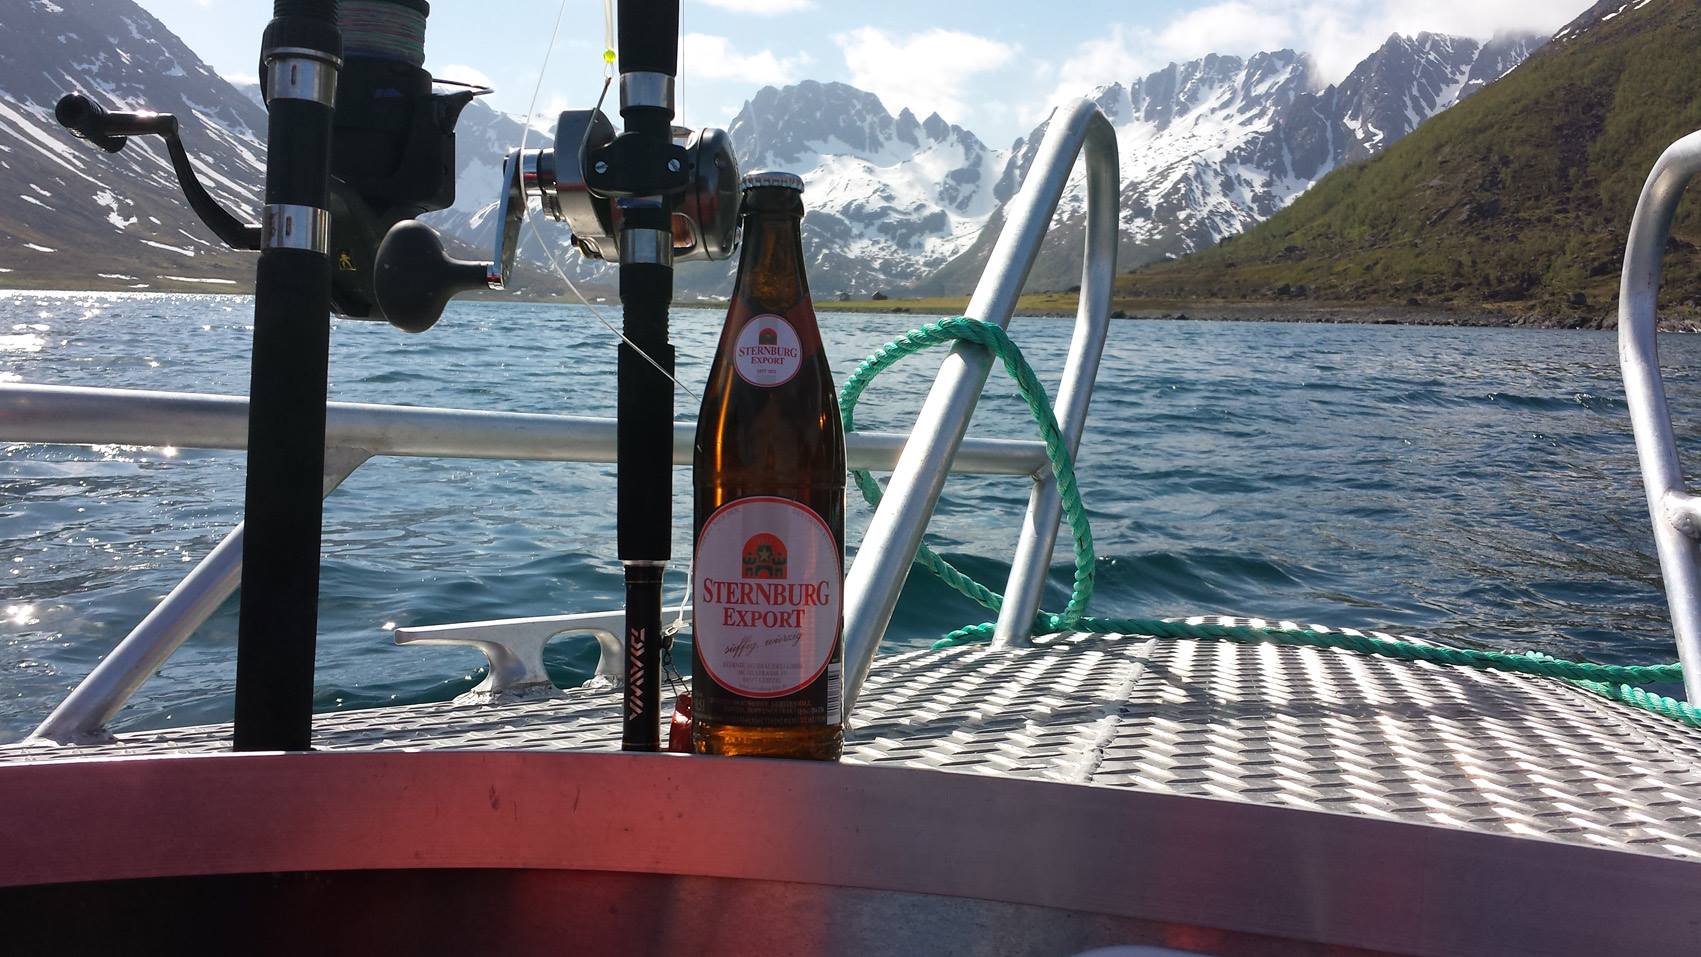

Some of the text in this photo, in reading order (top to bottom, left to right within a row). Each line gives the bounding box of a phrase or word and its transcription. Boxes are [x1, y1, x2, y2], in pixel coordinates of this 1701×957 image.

[738, 346, 798, 358] STERNBURG
[751, 356, 785, 365] EXPORT
[703, 578, 830, 606] STERNBURG
[722, 607, 806, 628] EXPORT
